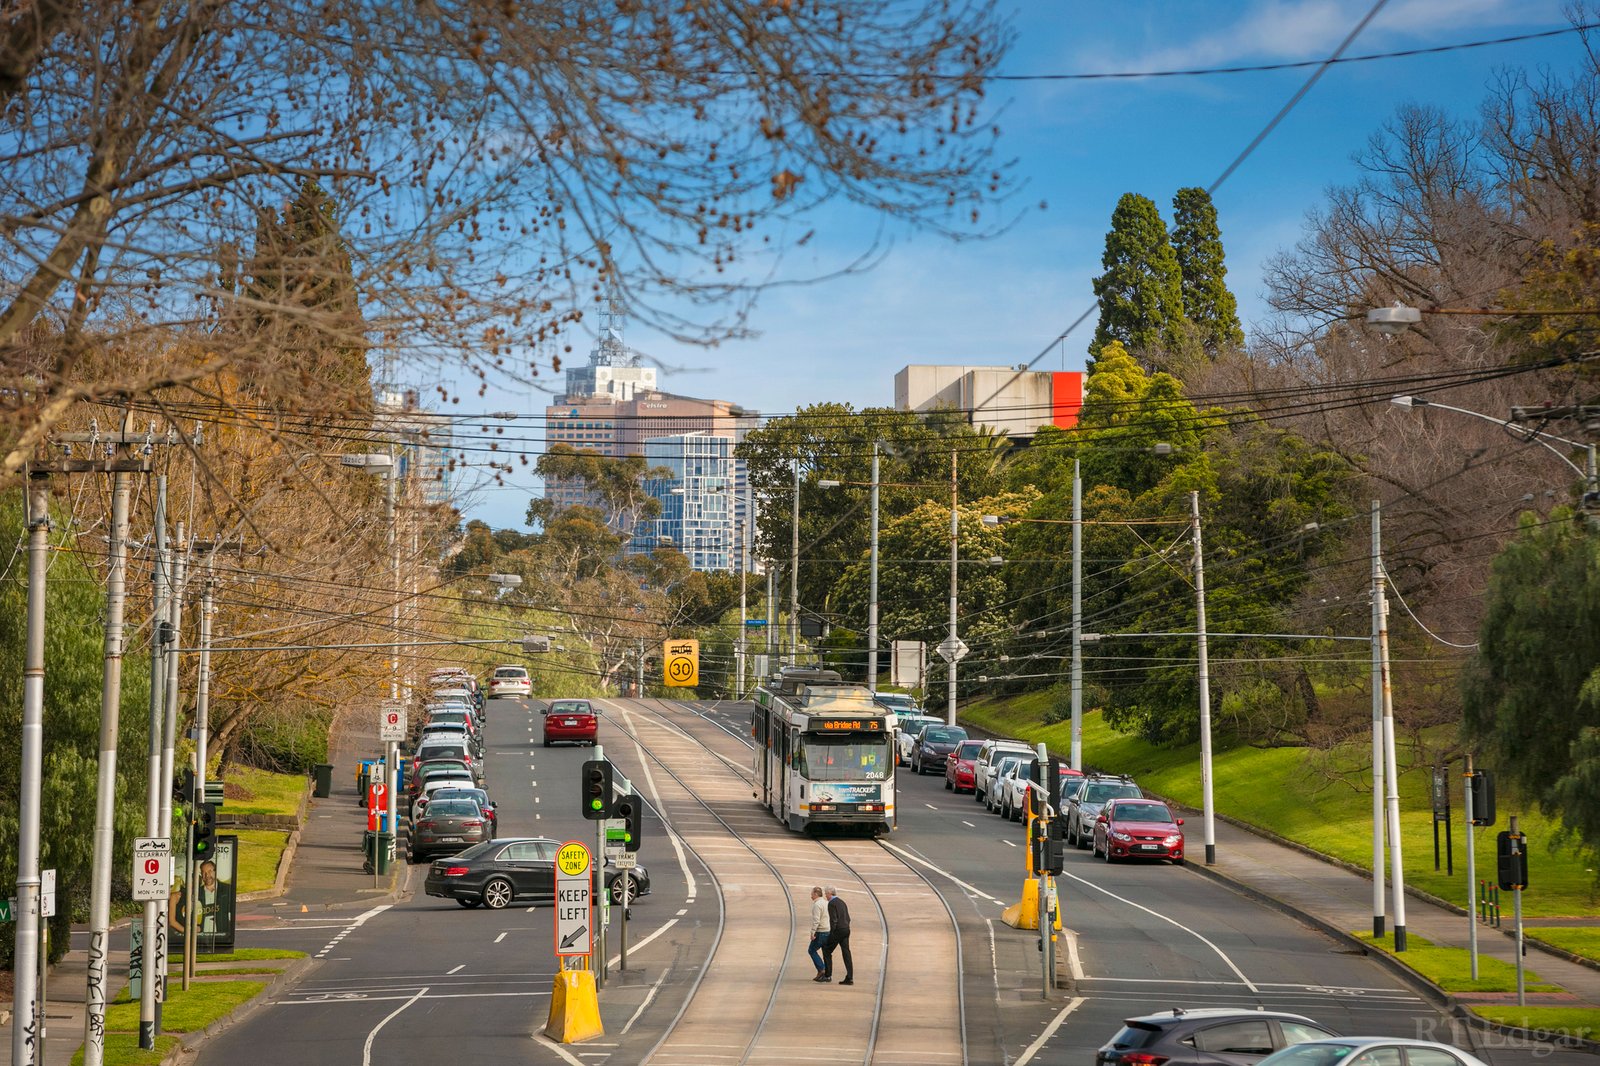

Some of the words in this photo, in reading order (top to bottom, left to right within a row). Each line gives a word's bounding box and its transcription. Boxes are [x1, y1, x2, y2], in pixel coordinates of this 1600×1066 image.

[673, 663, 690, 676] 30
[824, 721, 834, 729] via
[834, 721, 852, 729] Bridge
[853, 721, 860, 729] Rd
[869, 721, 878, 729] 75
[561, 850, 585, 860] SAFETY
[565, 862, 582, 870] ZONE
[559, 889, 588, 902] KEEP
[560, 907, 587, 920] LEFT
